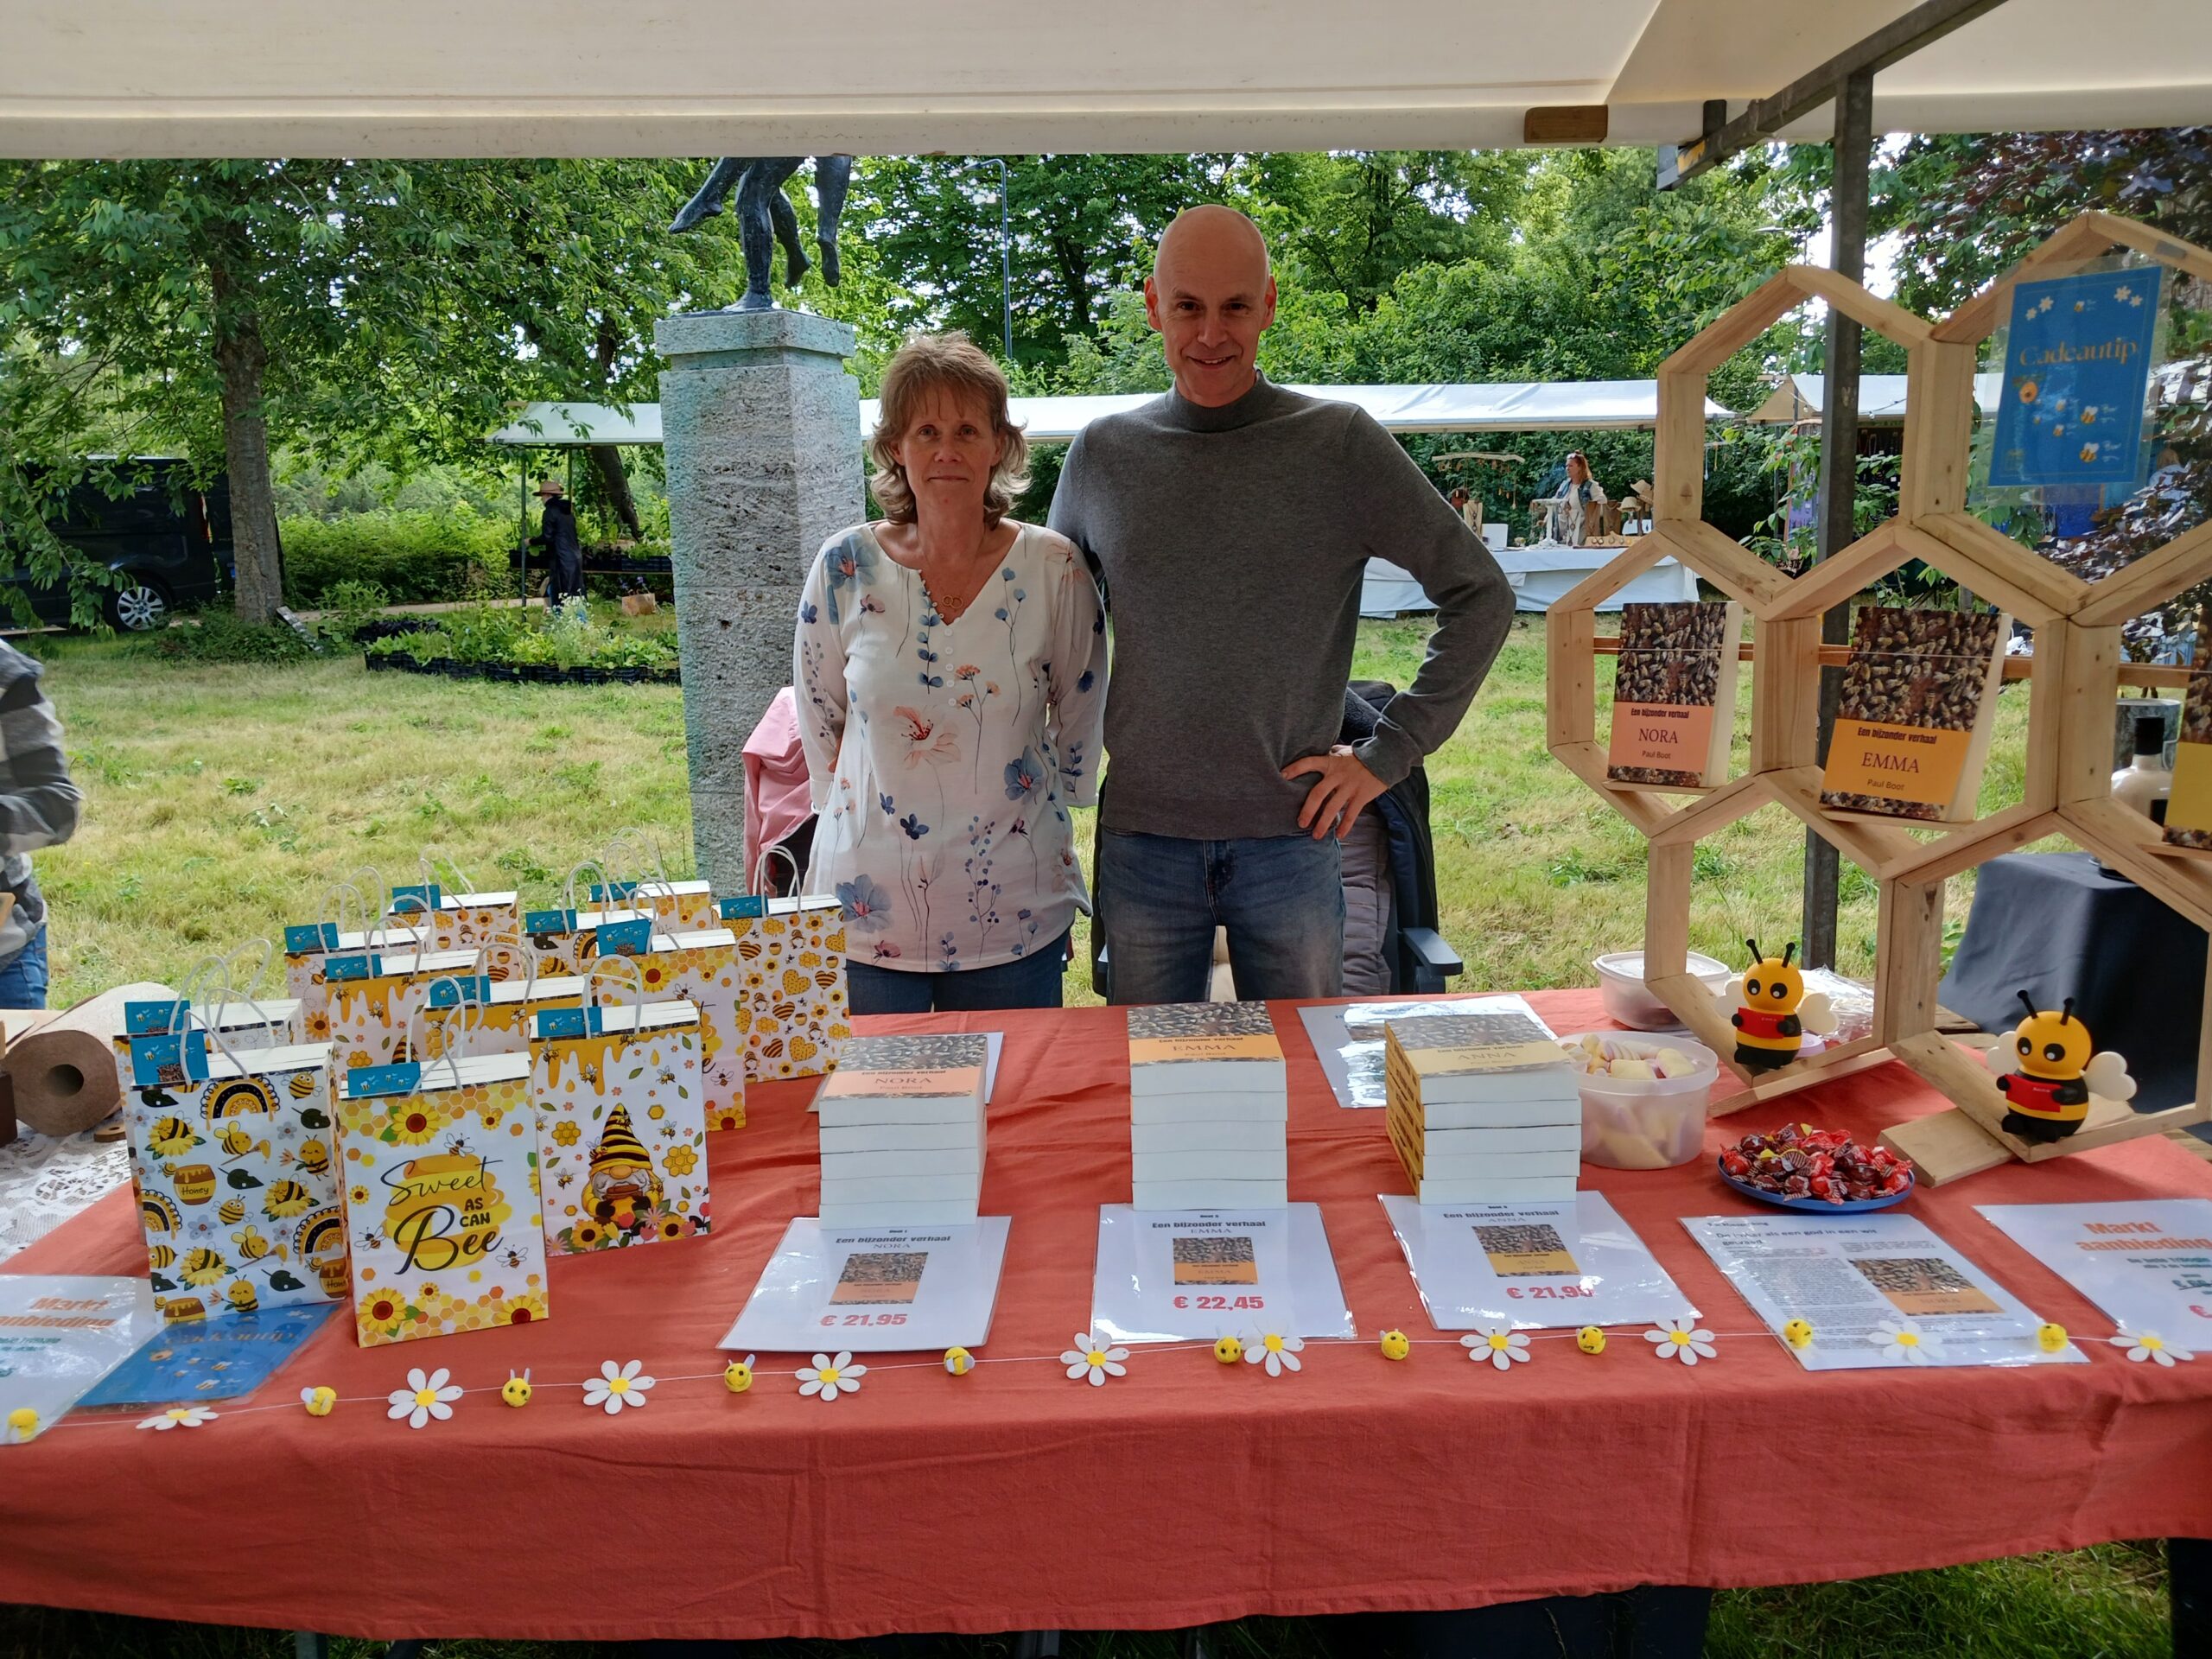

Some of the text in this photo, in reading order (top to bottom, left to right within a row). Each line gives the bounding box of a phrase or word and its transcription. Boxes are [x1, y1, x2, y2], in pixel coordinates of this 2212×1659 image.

[2019, 337, 2139, 366] Cadeautip
[1630, 708, 1689, 719] Een bijzonder verhaal
[1638, 728, 1678, 744] NORA
[1858, 727, 1937, 745] Een bijzonder verhaal
[1656, 751, 1671, 760] Boot
[1861, 752, 1920, 773] EMMA
[1866, 779, 1905, 791] Paul Boot
[1457, 1052, 1516, 1060] ANNA
[380, 1155, 504, 1206] Sweet
[181, 1185, 209, 1196] Honey
[464, 1197, 484, 1212] AS
[459, 1211, 491, 1227] CAN
[2082, 1221, 2164, 1234] Markt
[393, 1205, 504, 1275] Bee
[857, 1236, 908, 1244] bijzonder
[1506, 1287, 1524, 1300] €
[29, 1297, 109, 1312] Markt
[1173, 1296, 1264, 1311] € 22,45
[820, 1313, 908, 1327] € 21,95
